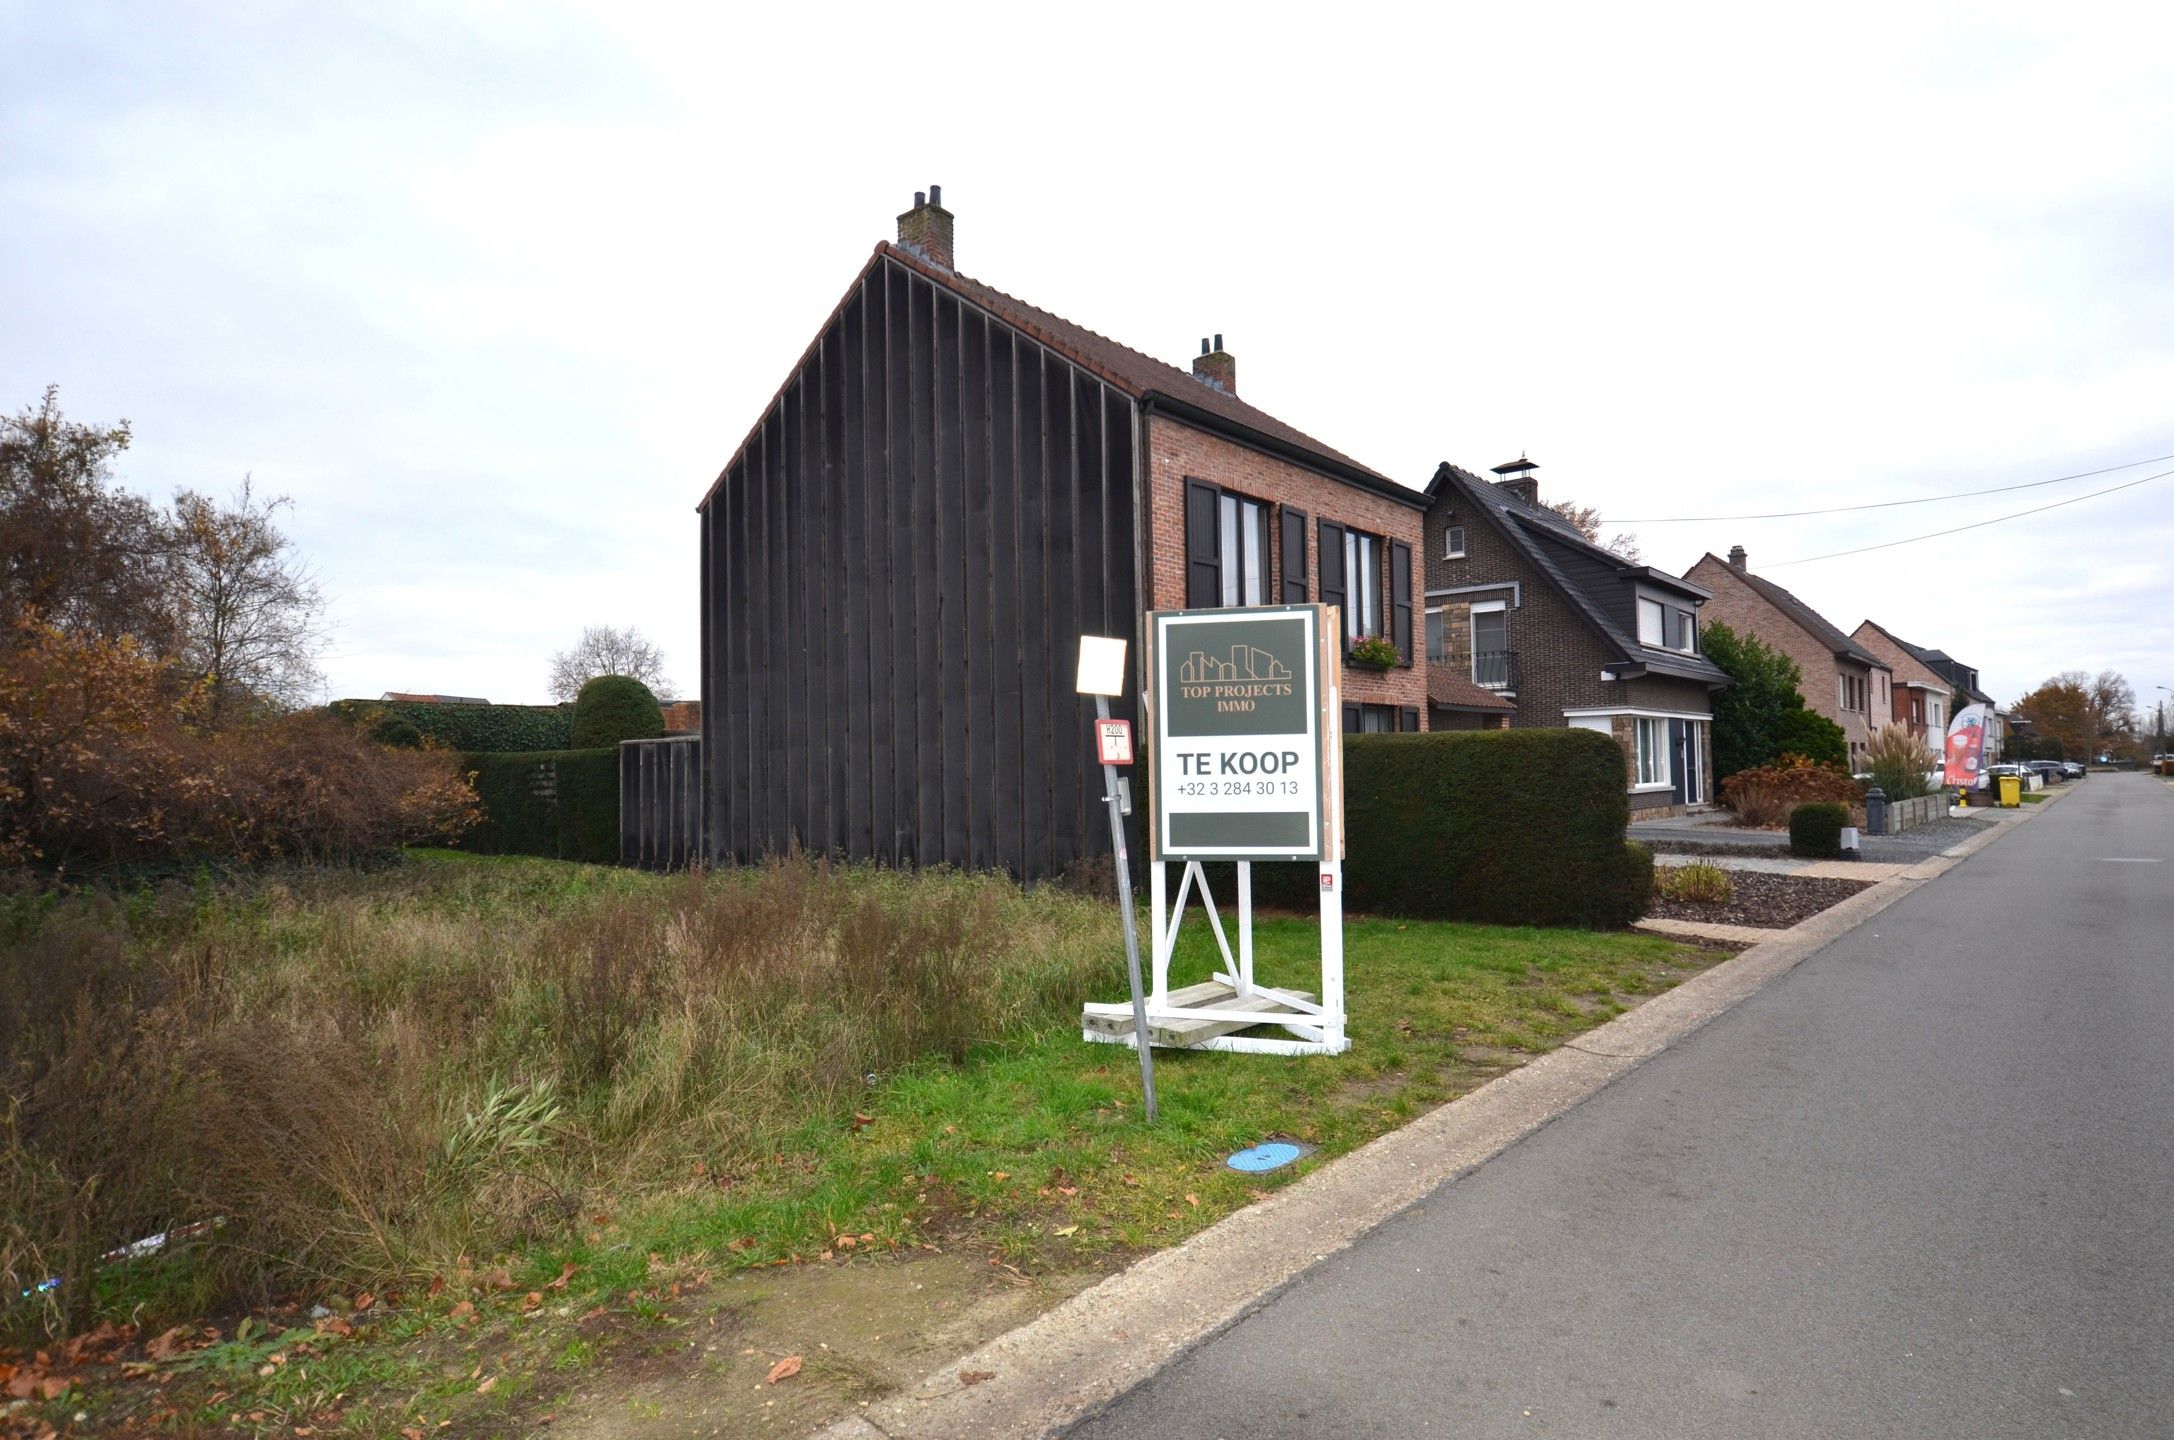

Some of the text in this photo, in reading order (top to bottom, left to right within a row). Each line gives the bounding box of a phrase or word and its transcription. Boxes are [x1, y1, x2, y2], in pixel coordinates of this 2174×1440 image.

[1181, 684, 1292, 698] TOP PROJECTS
[1217, 700, 1255, 712] IMMO
[1176, 752, 1299, 775] TE KOOP
[1178, 781, 1298, 795] +32 3 284 30 13
